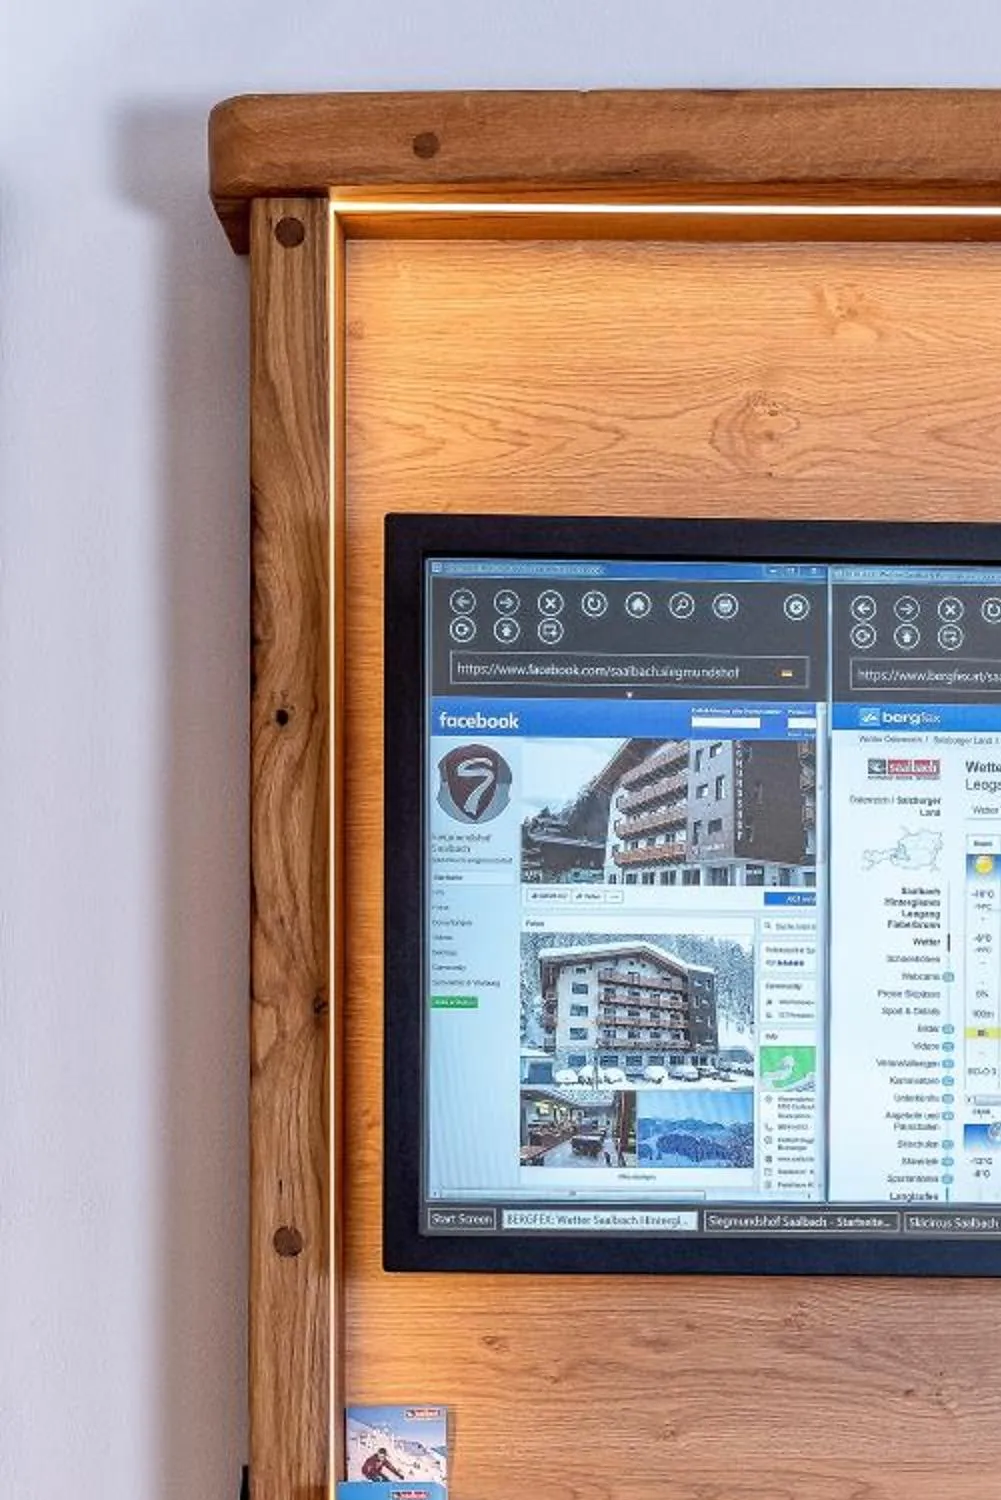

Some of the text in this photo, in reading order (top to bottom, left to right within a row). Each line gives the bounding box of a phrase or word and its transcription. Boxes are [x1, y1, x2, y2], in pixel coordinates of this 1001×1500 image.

[439, 711, 520, 729] facebook
[431, 1213, 493, 1225] Start Screen
[783, 1216, 828, 1227] Saalbach
[955, 1217, 999, 1229] Saalbach
